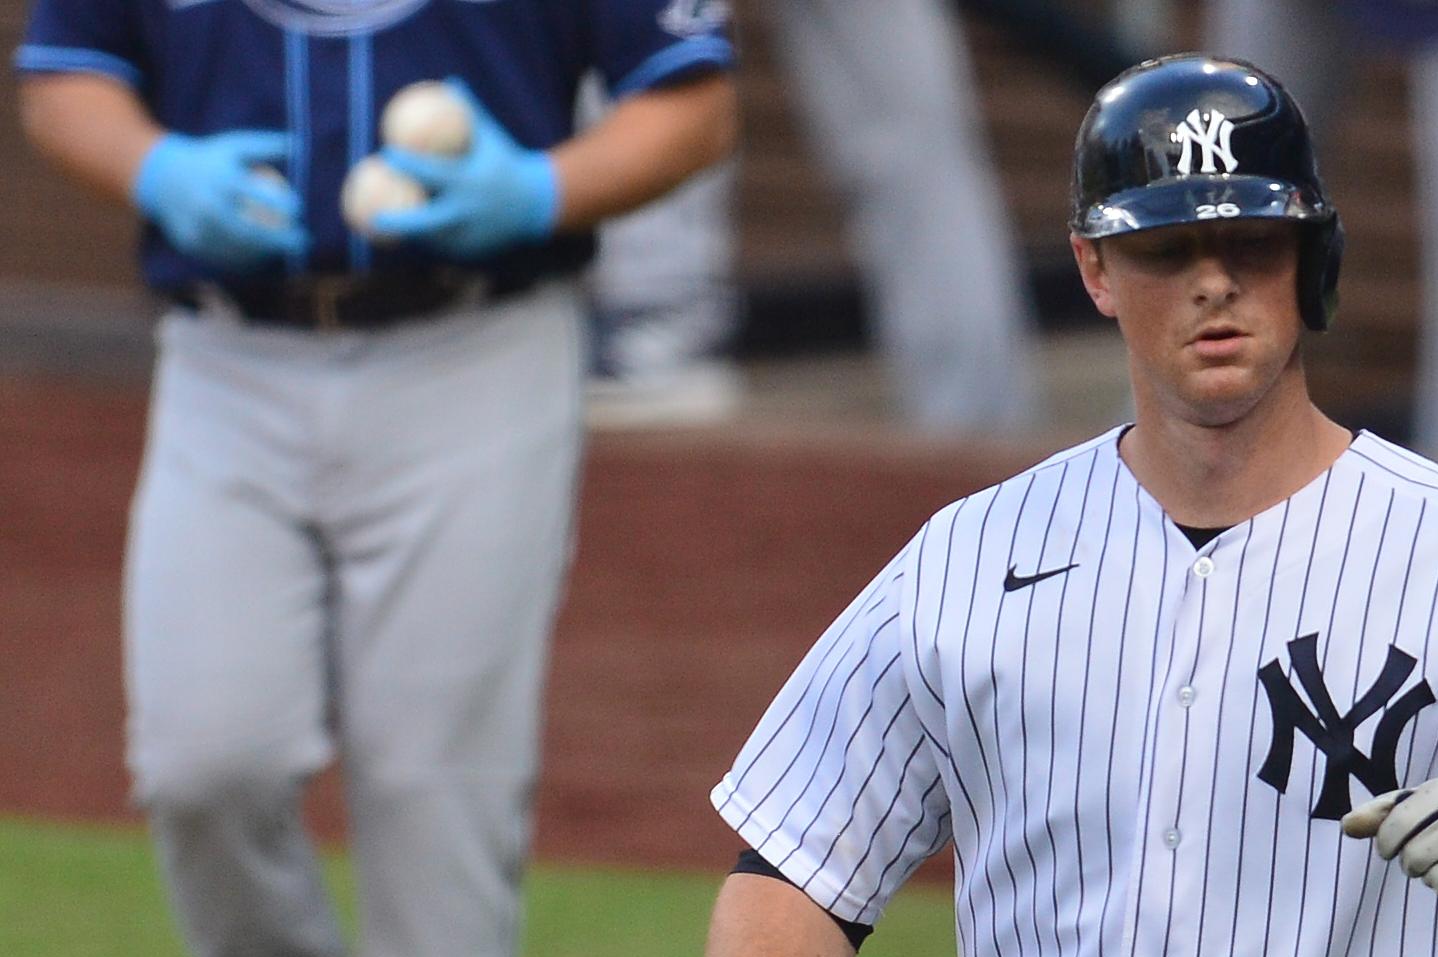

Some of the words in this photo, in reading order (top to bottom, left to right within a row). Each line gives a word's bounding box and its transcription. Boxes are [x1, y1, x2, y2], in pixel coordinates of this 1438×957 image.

[1176, 109, 1239, 175] NY
[1195, 203, 1241, 219] 26
[1257, 632, 1437, 821] NY
